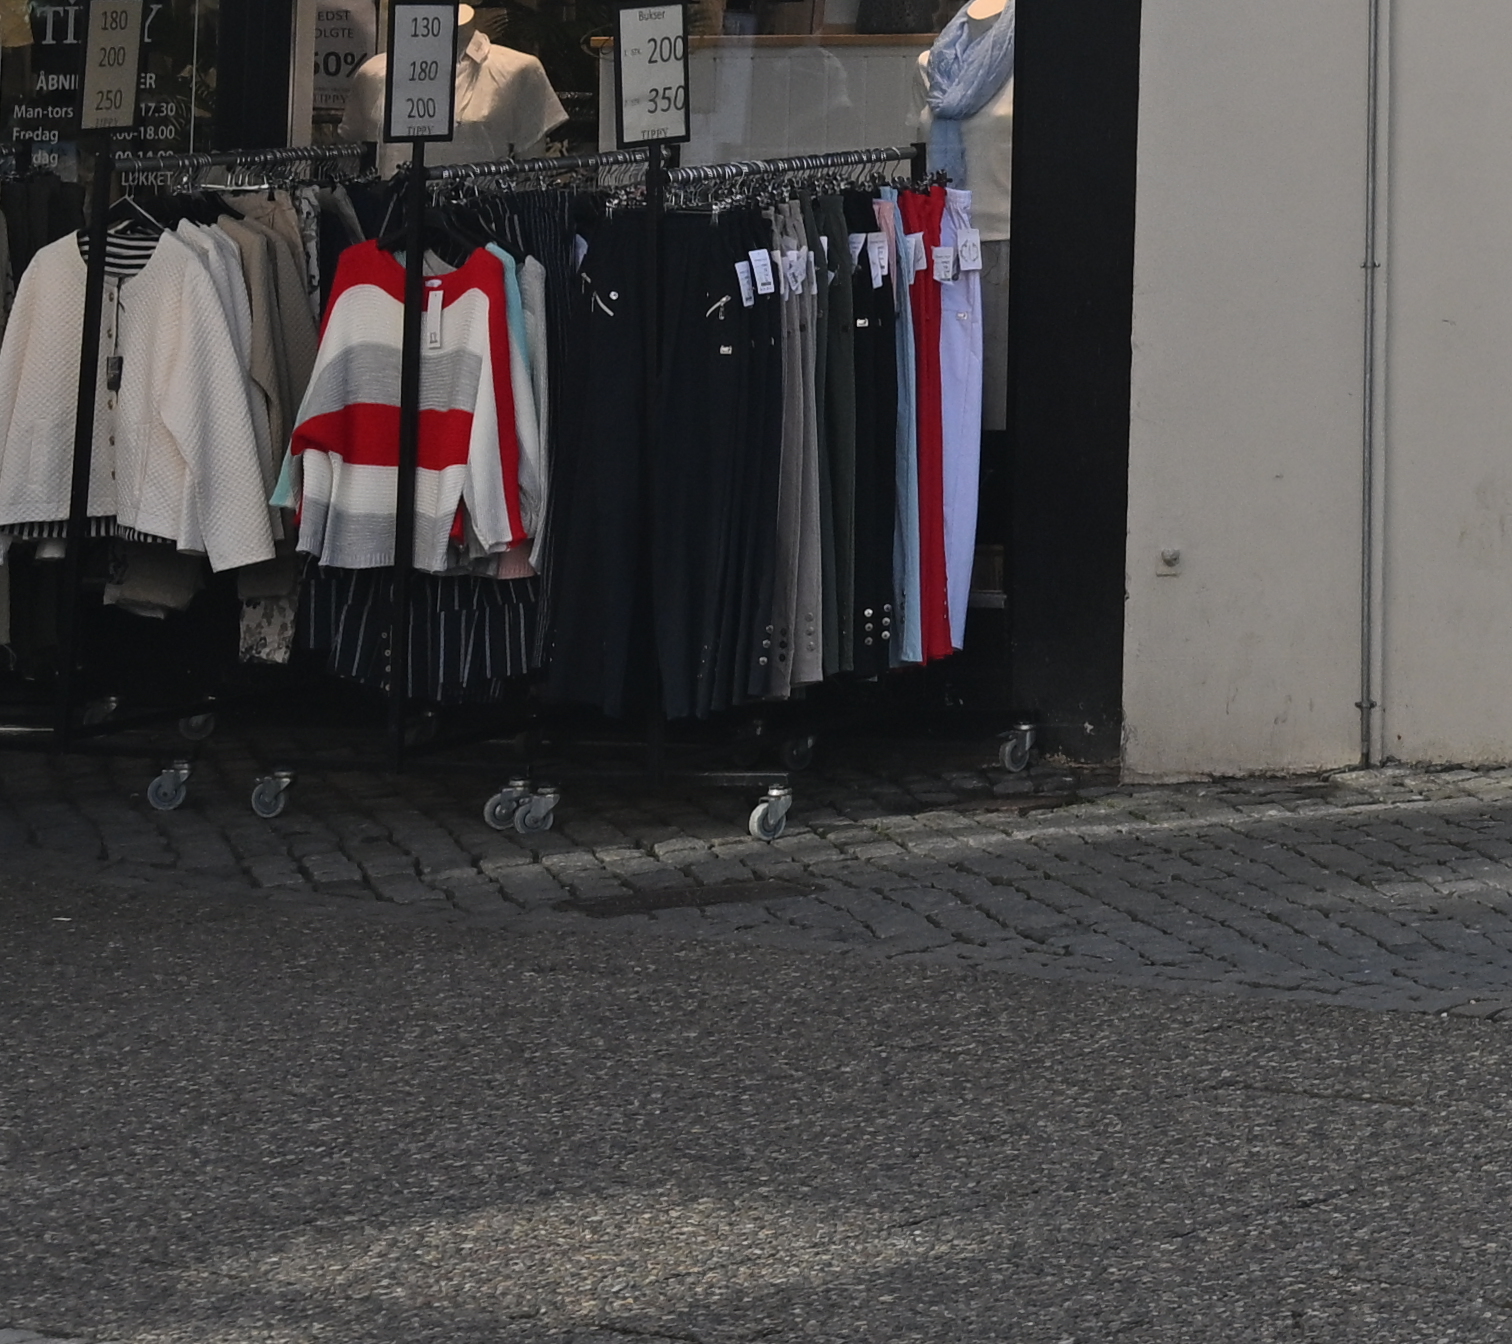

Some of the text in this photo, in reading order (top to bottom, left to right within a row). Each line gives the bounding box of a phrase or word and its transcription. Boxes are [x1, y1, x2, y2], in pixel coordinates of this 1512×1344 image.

[101, 10, 128, 30] 180
[317, 10, 350, 22] EDST
[410, 16, 441, 38] 130
[98, 46, 126, 67] 200
[647, 35, 684, 64] 200
[409, 60, 439, 81] 180
[95, 89, 123, 111] 250
[406, 97, 436, 119] 200
[648, 85, 686, 114] 350
[13, 104, 74, 119] Man-tors
[13, 127, 59, 144] Fredag
